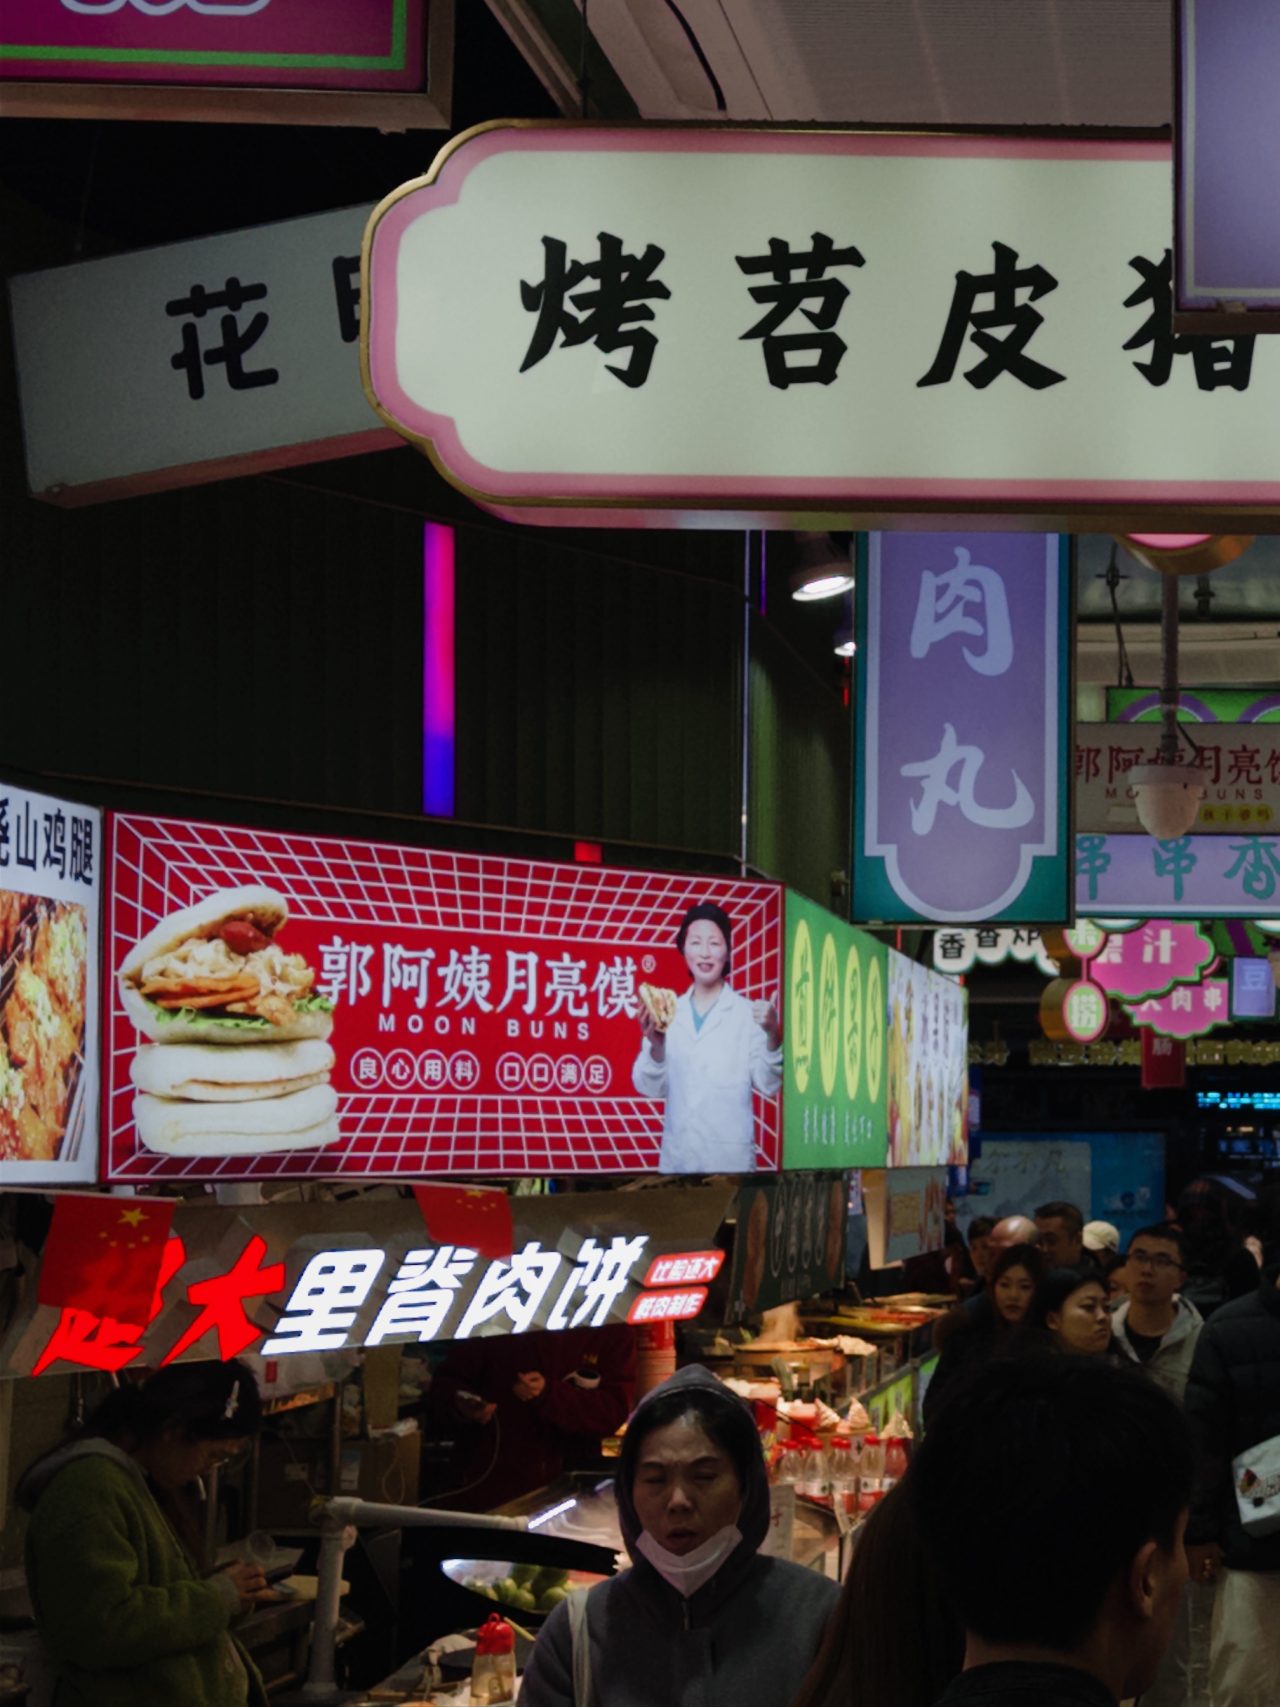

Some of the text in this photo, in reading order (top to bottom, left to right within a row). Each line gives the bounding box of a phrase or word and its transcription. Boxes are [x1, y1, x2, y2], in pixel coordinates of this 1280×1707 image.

[900, 545, 1036, 836] 肉丸
[316, 935, 640, 1020] 郭阿姨月亮馍
[378, 1012, 591, 1041] MOON BUNS
[357, 1056, 606, 1086] 良心用料 口口满足
